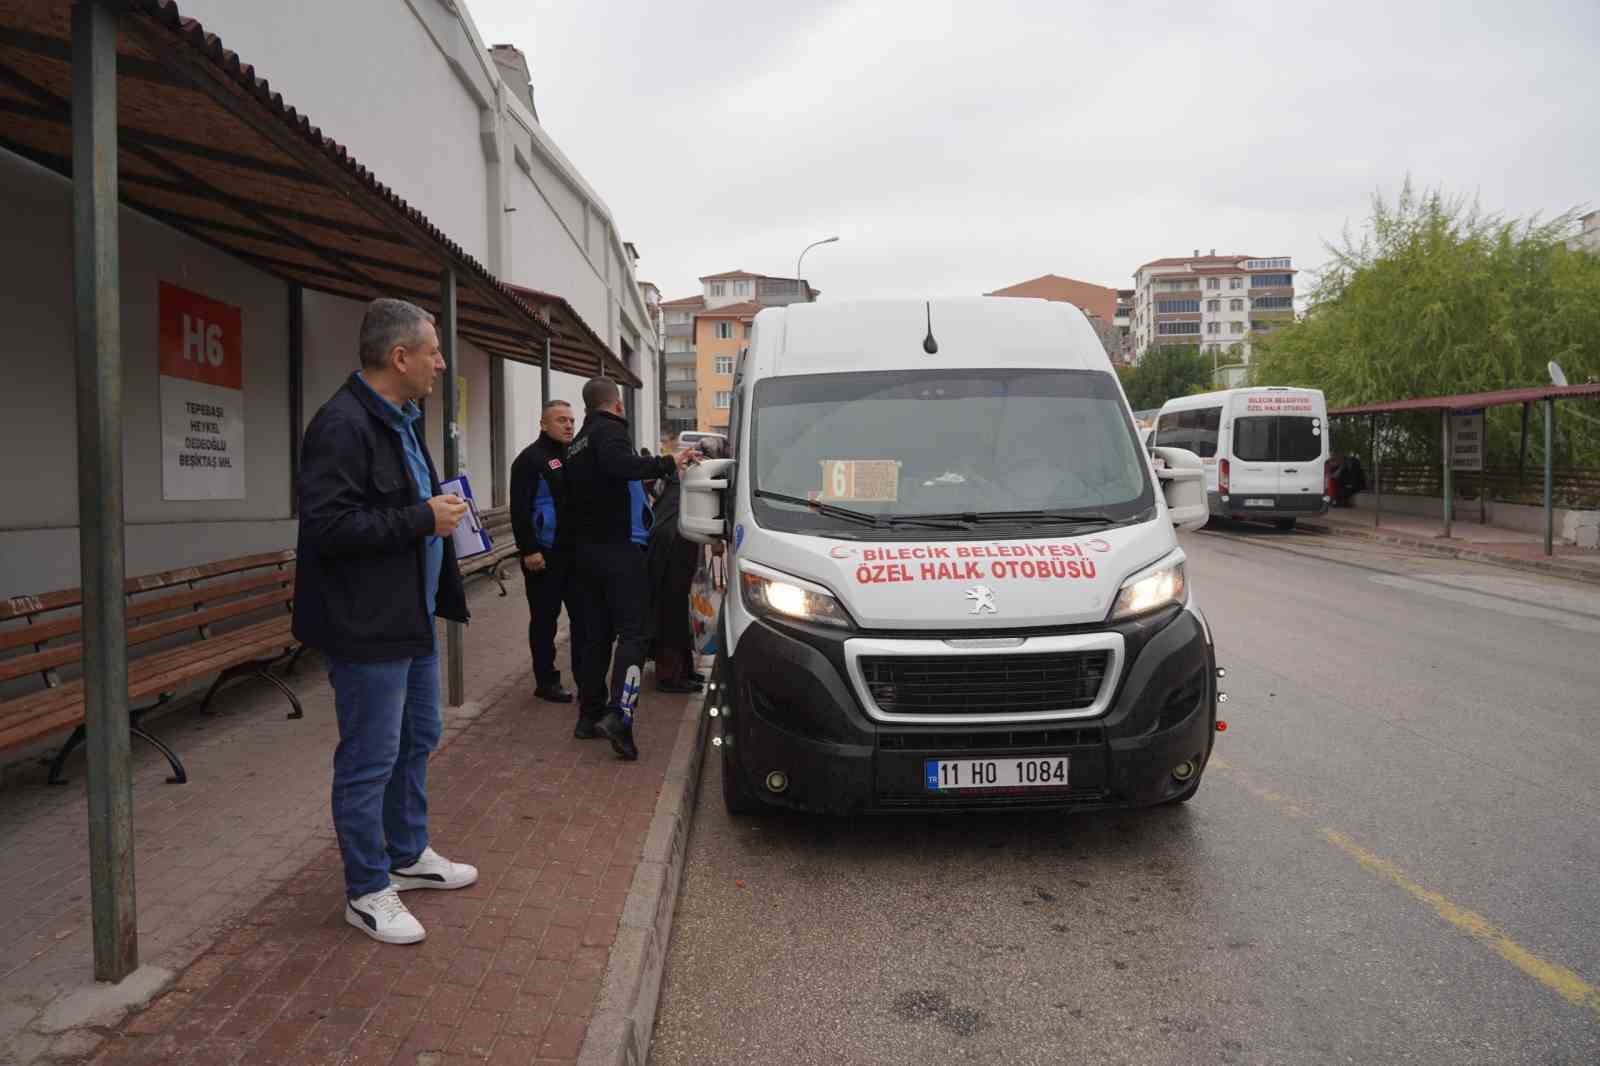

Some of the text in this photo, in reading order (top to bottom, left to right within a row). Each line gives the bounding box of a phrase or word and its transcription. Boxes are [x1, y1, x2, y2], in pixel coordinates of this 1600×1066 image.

[183, 312, 224, 368] H6
[190, 420, 220, 434] HEYKEL
[179, 453, 217, 470] BEŞİKTAŞ
[832, 462, 847, 497] 6
[863, 542, 1084, 561] BİLECİK BELEDİYESİ
[856, 558, 1097, 584] ÖZEL HALK OTOBÜSÜ
[928, 776, 938, 784] TR
[941, 763, 959, 785] 11
[1016, 760, 1065, 783] 1084
